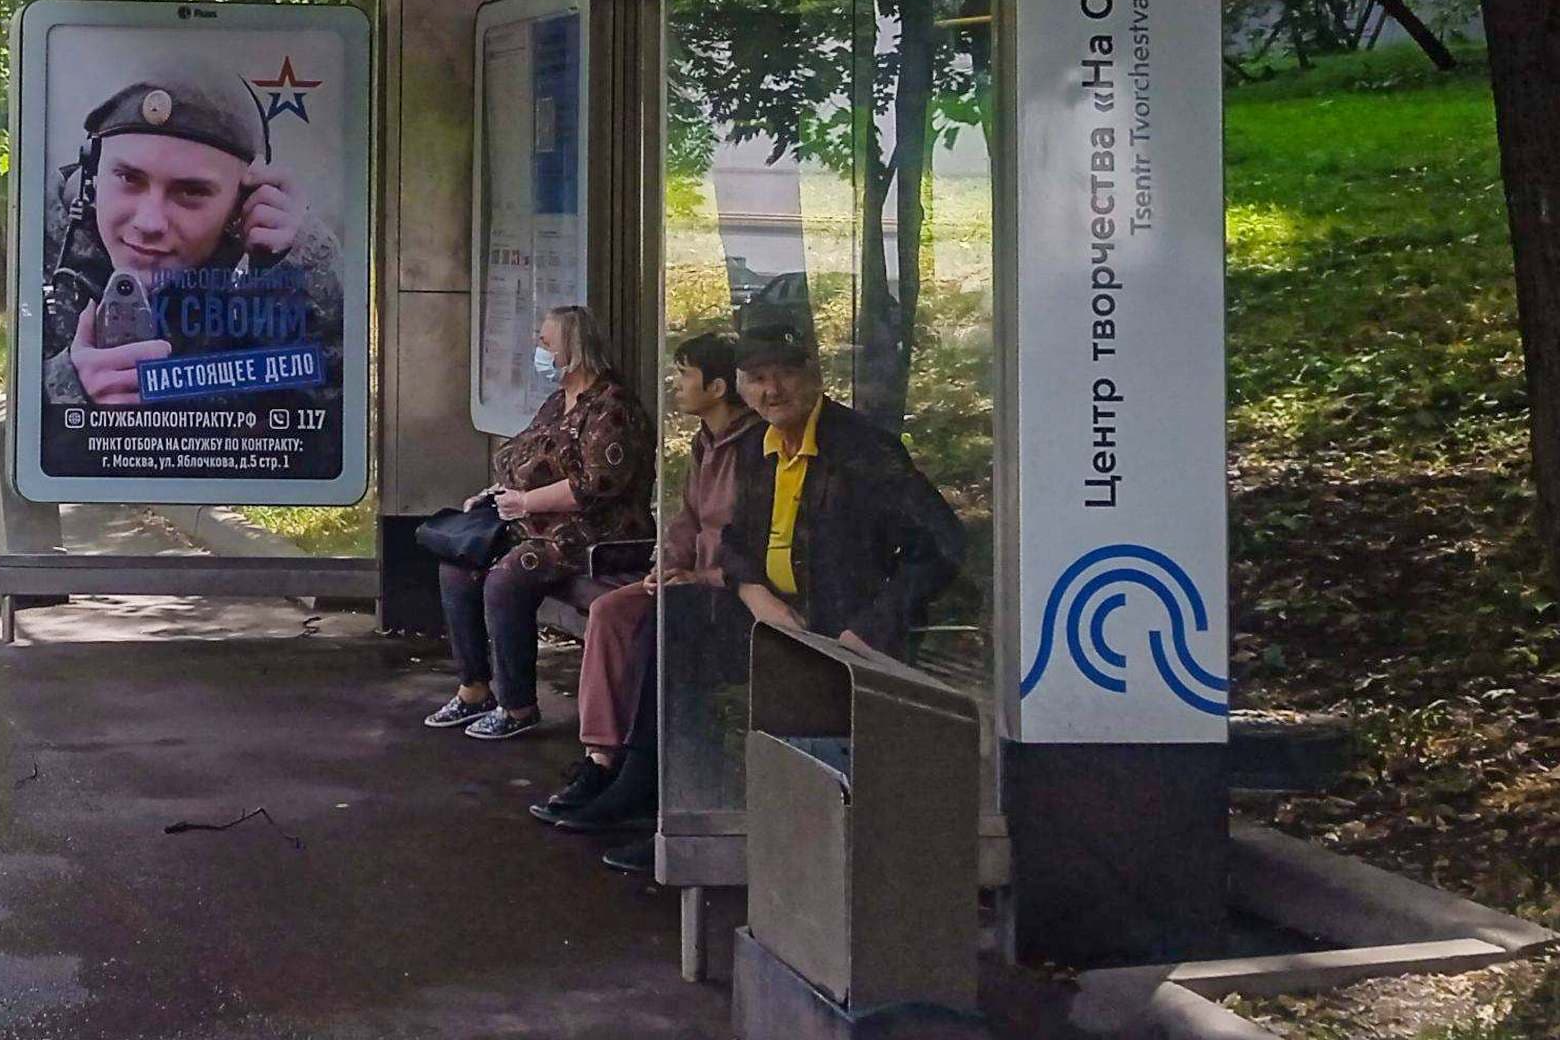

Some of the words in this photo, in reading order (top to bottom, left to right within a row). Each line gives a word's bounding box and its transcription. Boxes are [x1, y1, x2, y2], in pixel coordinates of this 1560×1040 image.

[1081, 34, 1114, 112] «На
[1130, 153, 1151, 235] Tsentr
[1091, 127, 1123, 361] творчества
[181, 296, 307, 339] СВОИМ
[147, 359, 256, 391] НАСТОЯЩЕЕ
[265, 353, 314, 383] ДЕЛО
[90, 411, 257, 428] СЛУЖБАПОКОНТРАКТУ.РФ
[298, 409, 326, 430] 117
[88, 437, 121, 450] ПУНКТ
[123, 437, 163, 450] ОТБОРА
[166, 437, 179, 450] НА
[181, 438, 224, 451] СЛУЖБУ
[225, 438, 239, 451] ПО
[242, 438, 303, 451] КОНТРАКТУ:
[102, 456, 110, 468] г.
[113, 454, 158, 469] Москва,
[159, 457, 175, 470] ул.
[177, 454, 238, 469] Яблочкова,
[240, 455, 257, 468] д.5
[259, 457, 281, 470] стр.
[283, 455, 290, 468] 1
[1084, 378, 1123, 507] Центр
